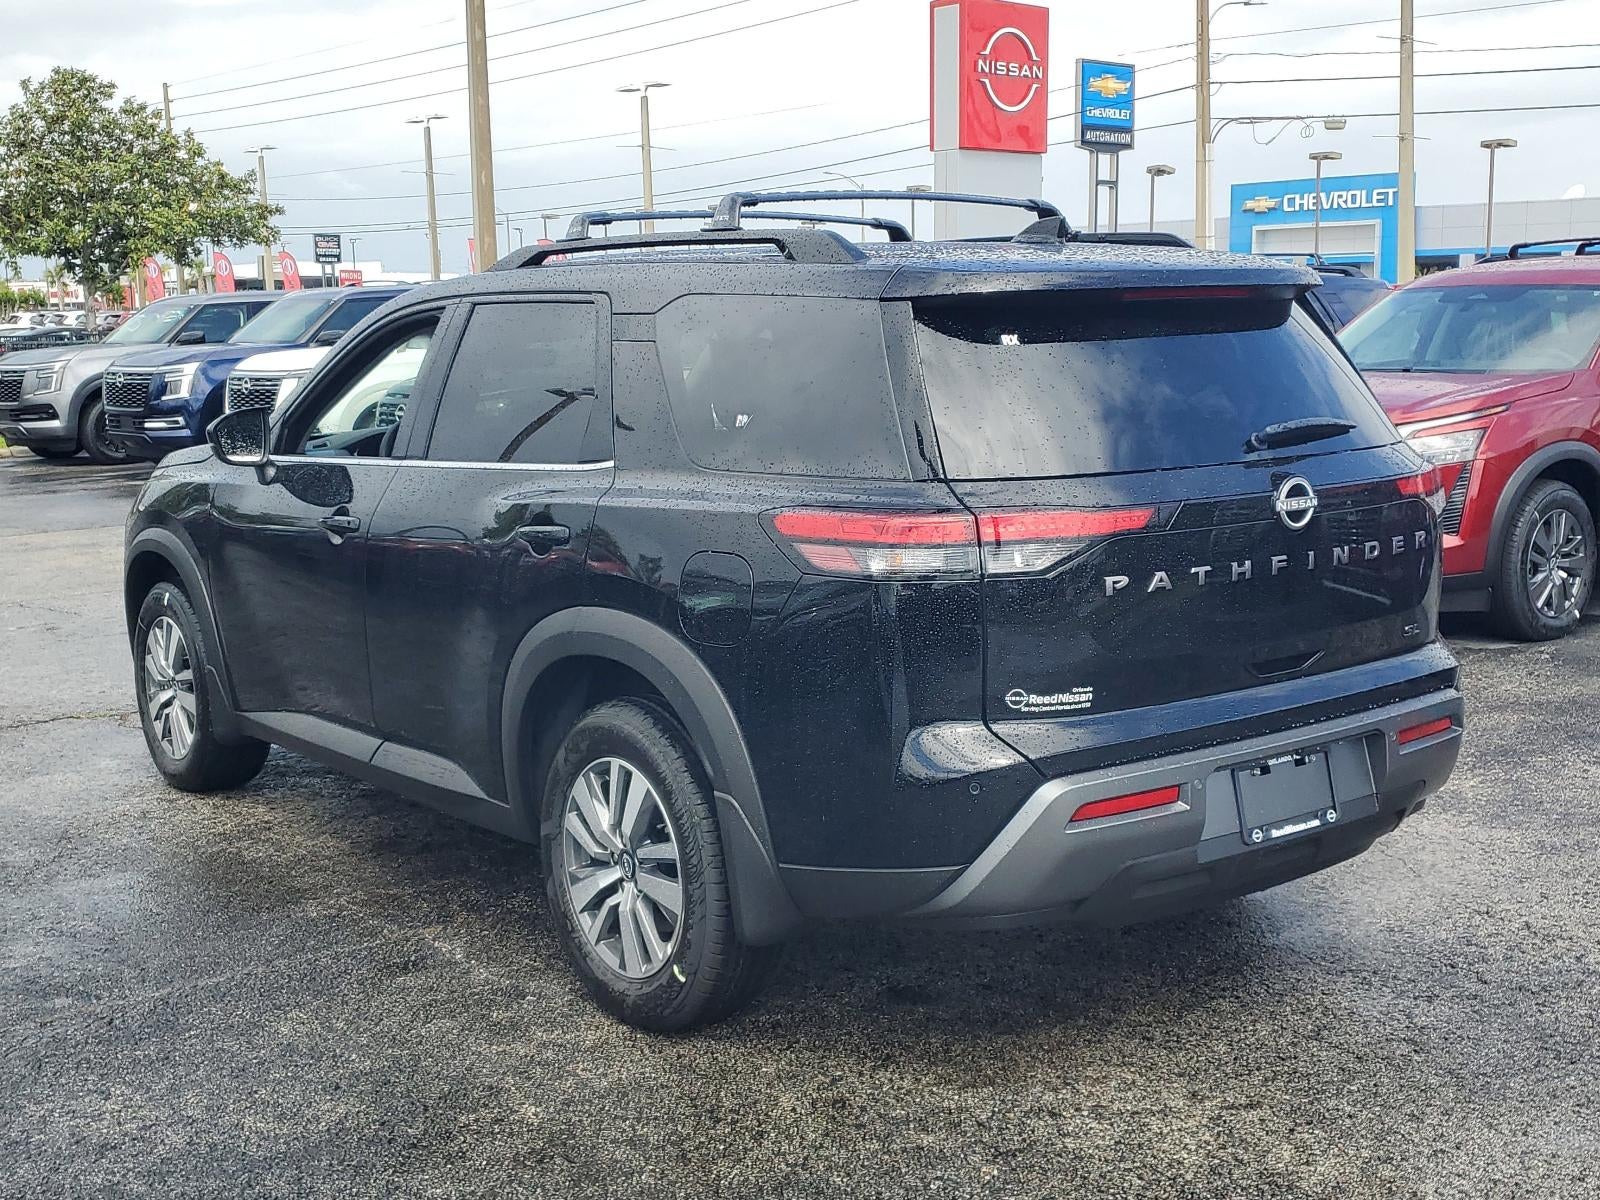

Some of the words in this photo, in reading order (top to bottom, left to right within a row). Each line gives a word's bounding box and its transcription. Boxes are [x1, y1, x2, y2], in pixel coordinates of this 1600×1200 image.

[978, 58, 1043, 79] NISSAN
[1086, 106, 1131, 120] CHEVROLET
[1086, 130, 1131, 144] AUTONATION
[1283, 187, 1399, 212] CHEVROLET
[340, 272, 362, 280] WRONG
[1278, 496, 1318, 511] NISSAN
[1103, 530, 1427, 597] PATHFINDER
